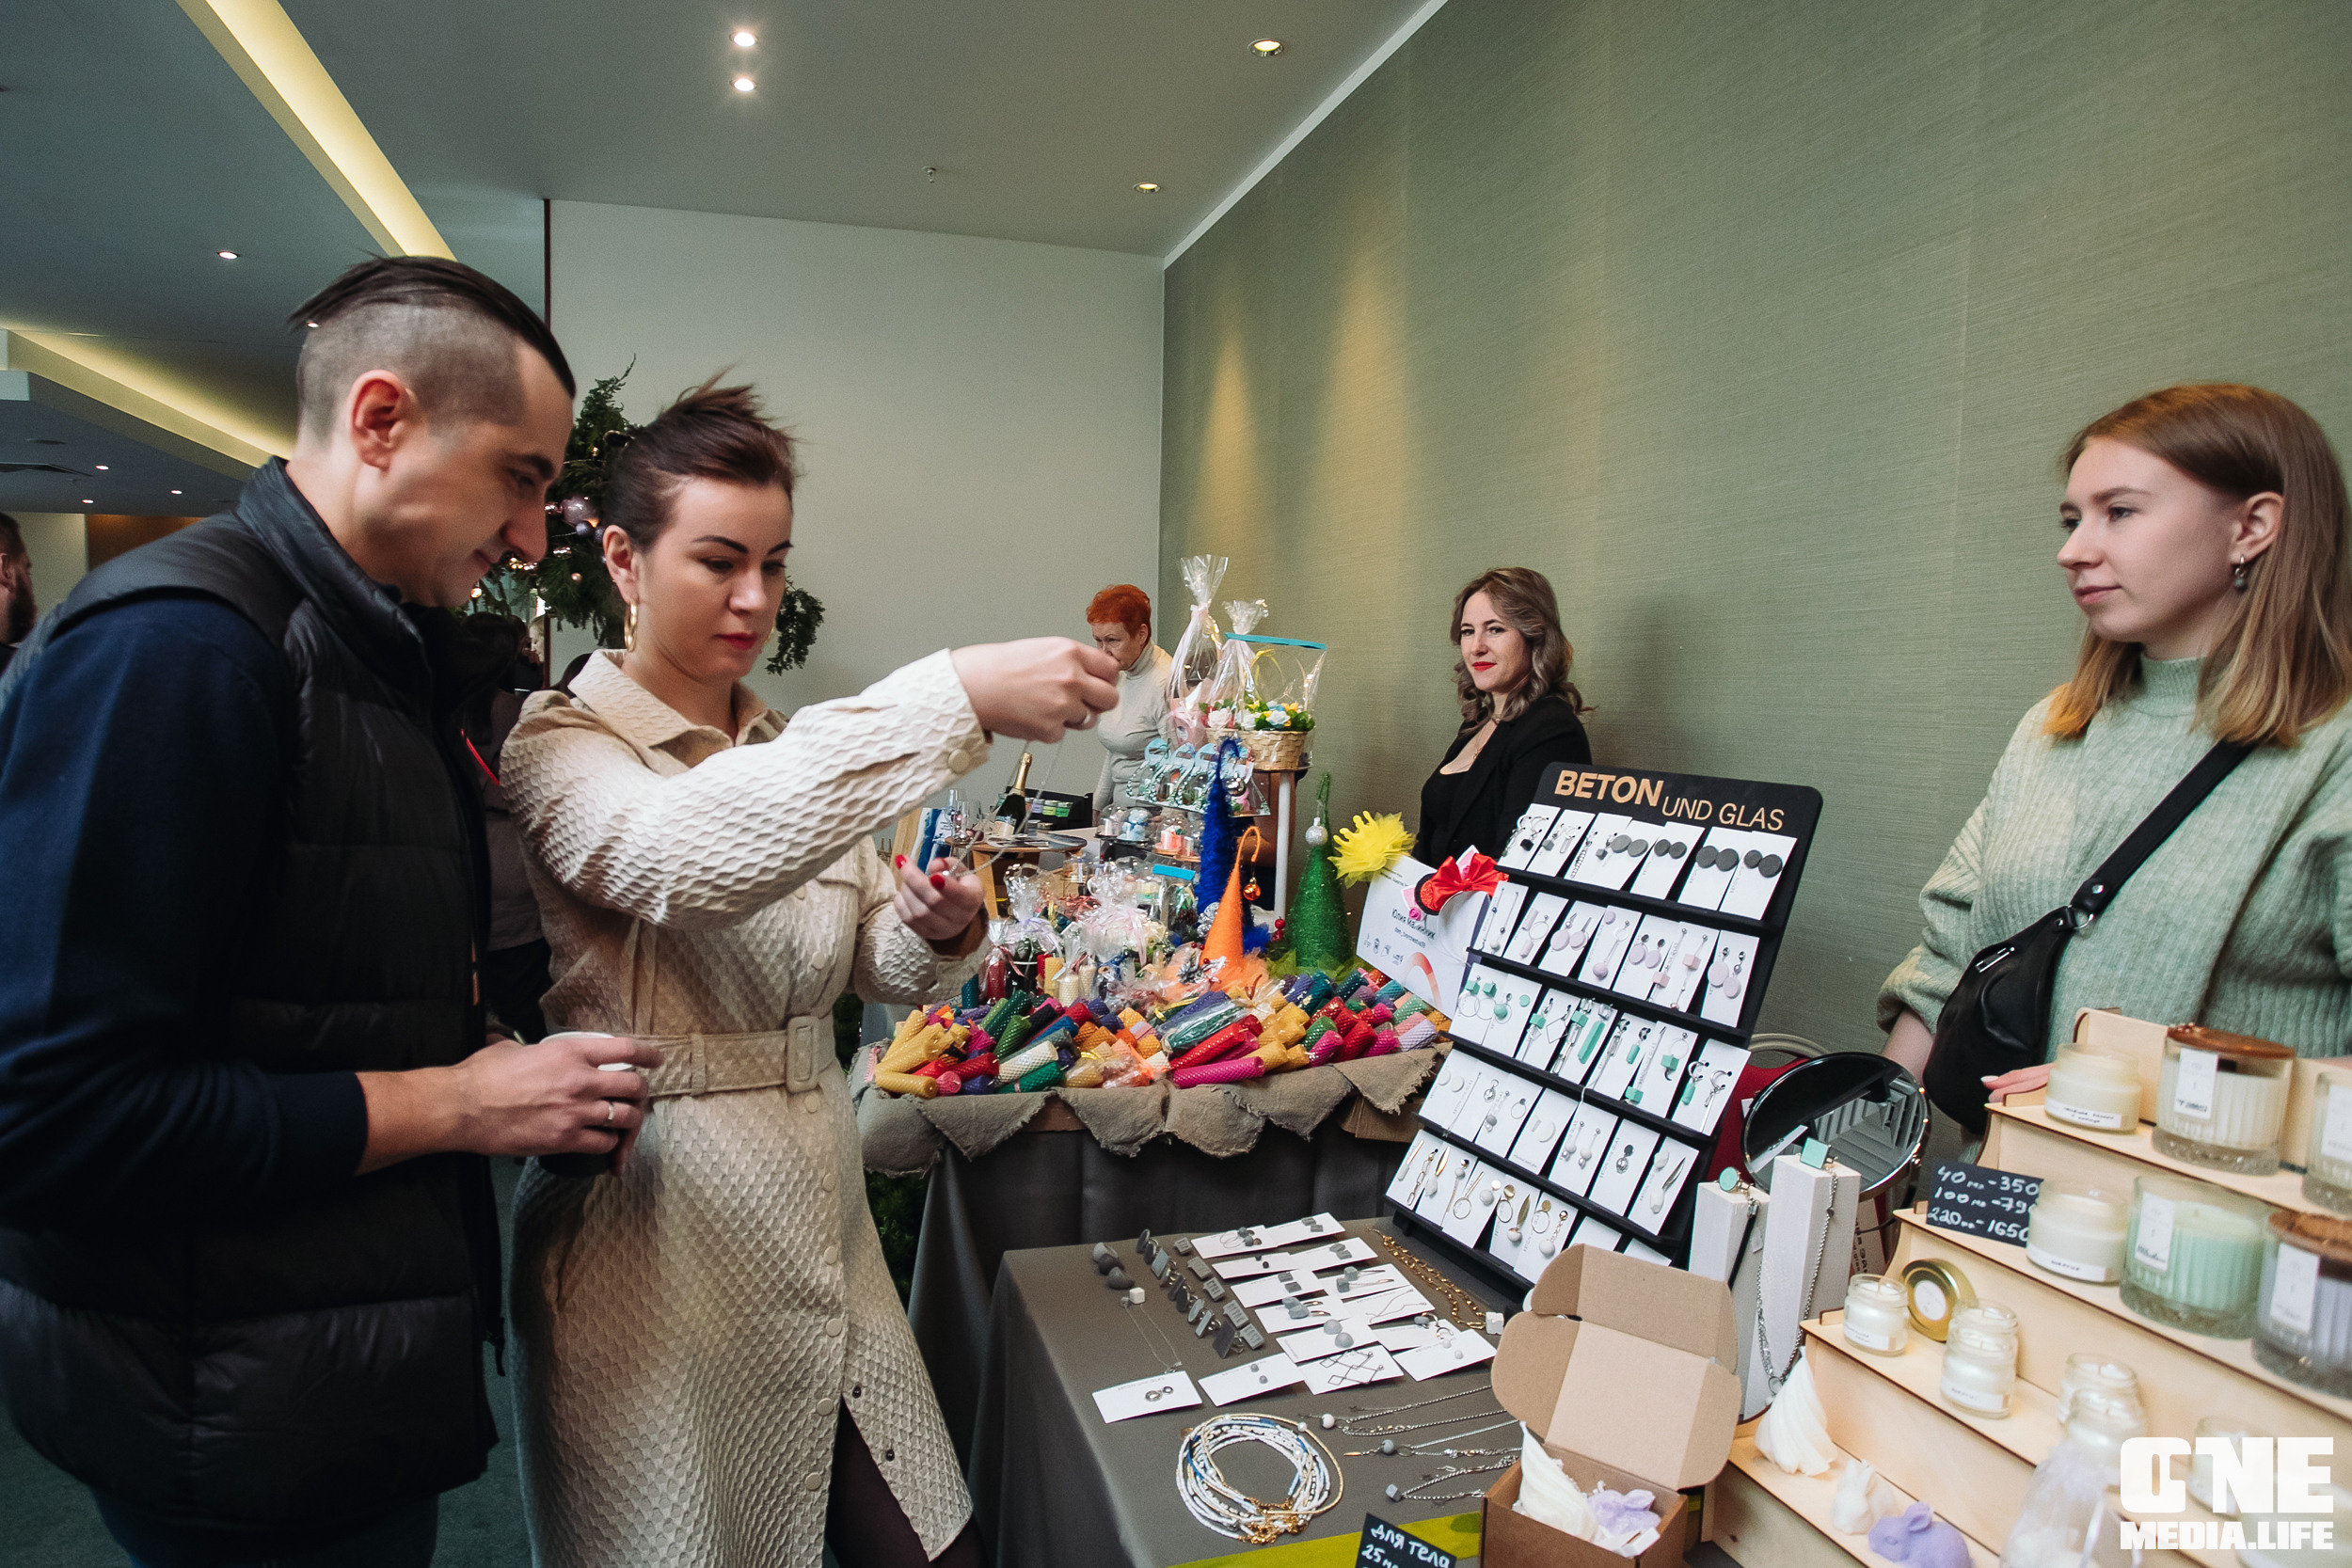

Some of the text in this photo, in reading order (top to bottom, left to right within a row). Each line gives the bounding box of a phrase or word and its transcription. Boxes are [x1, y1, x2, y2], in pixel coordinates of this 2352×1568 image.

[1554, 769, 1785, 832] BETON UND GLAS
